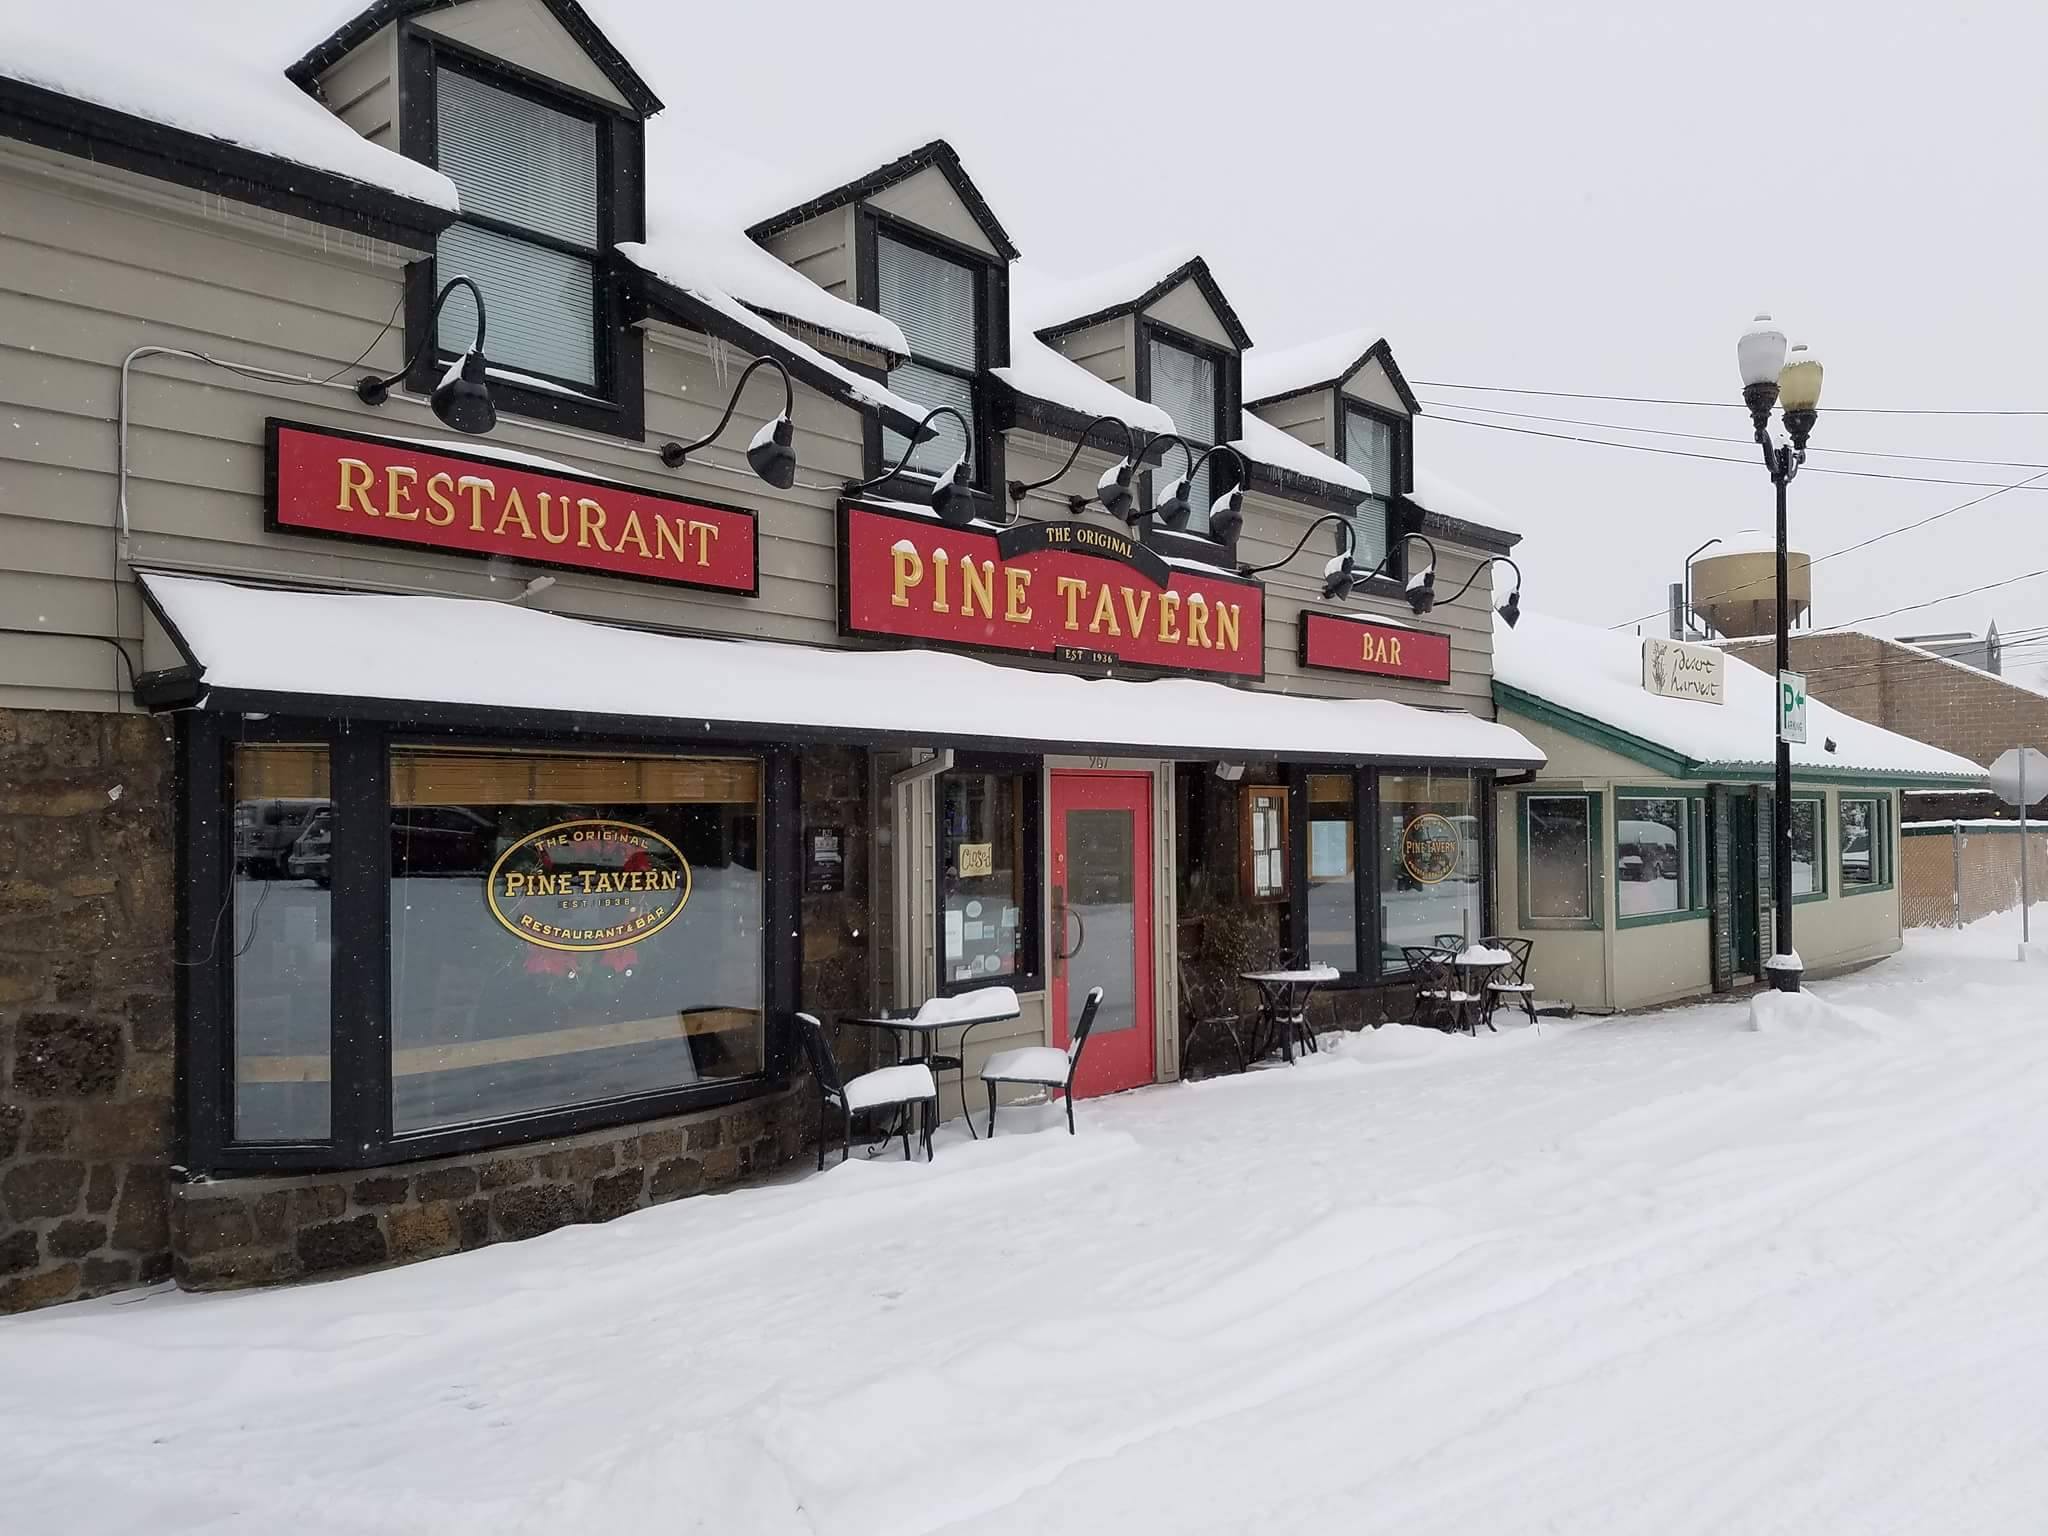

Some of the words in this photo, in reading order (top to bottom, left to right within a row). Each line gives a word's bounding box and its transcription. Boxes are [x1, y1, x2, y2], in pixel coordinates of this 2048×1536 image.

[336, 458, 719, 566] RESTAURANT
[1046, 527, 1071, 542] THE
[1077, 529, 1133, 558] ORIGINAL
[891, 541, 1033, 624] PINE
[1057, 576, 1241, 652] TAVERN
[1065, 649, 1083, 661] EST
[1093, 653, 1113, 664] 1936
[1362, 632, 1402, 666] BAR
[1671, 664, 1720, 696] harvest
[535, 834, 568, 851] THE
[573, 831, 649, 849] ORIGINAL
[1426, 841, 1456, 854] TAVERN
[505, 871, 573, 897] PINE
[578, 870, 678, 894] TAVERN
[562, 901, 588, 909] EST
[521, 914, 624, 939] RESTAURANT
[627, 924, 633, 932] &
[635, 907, 665, 928] BAR
